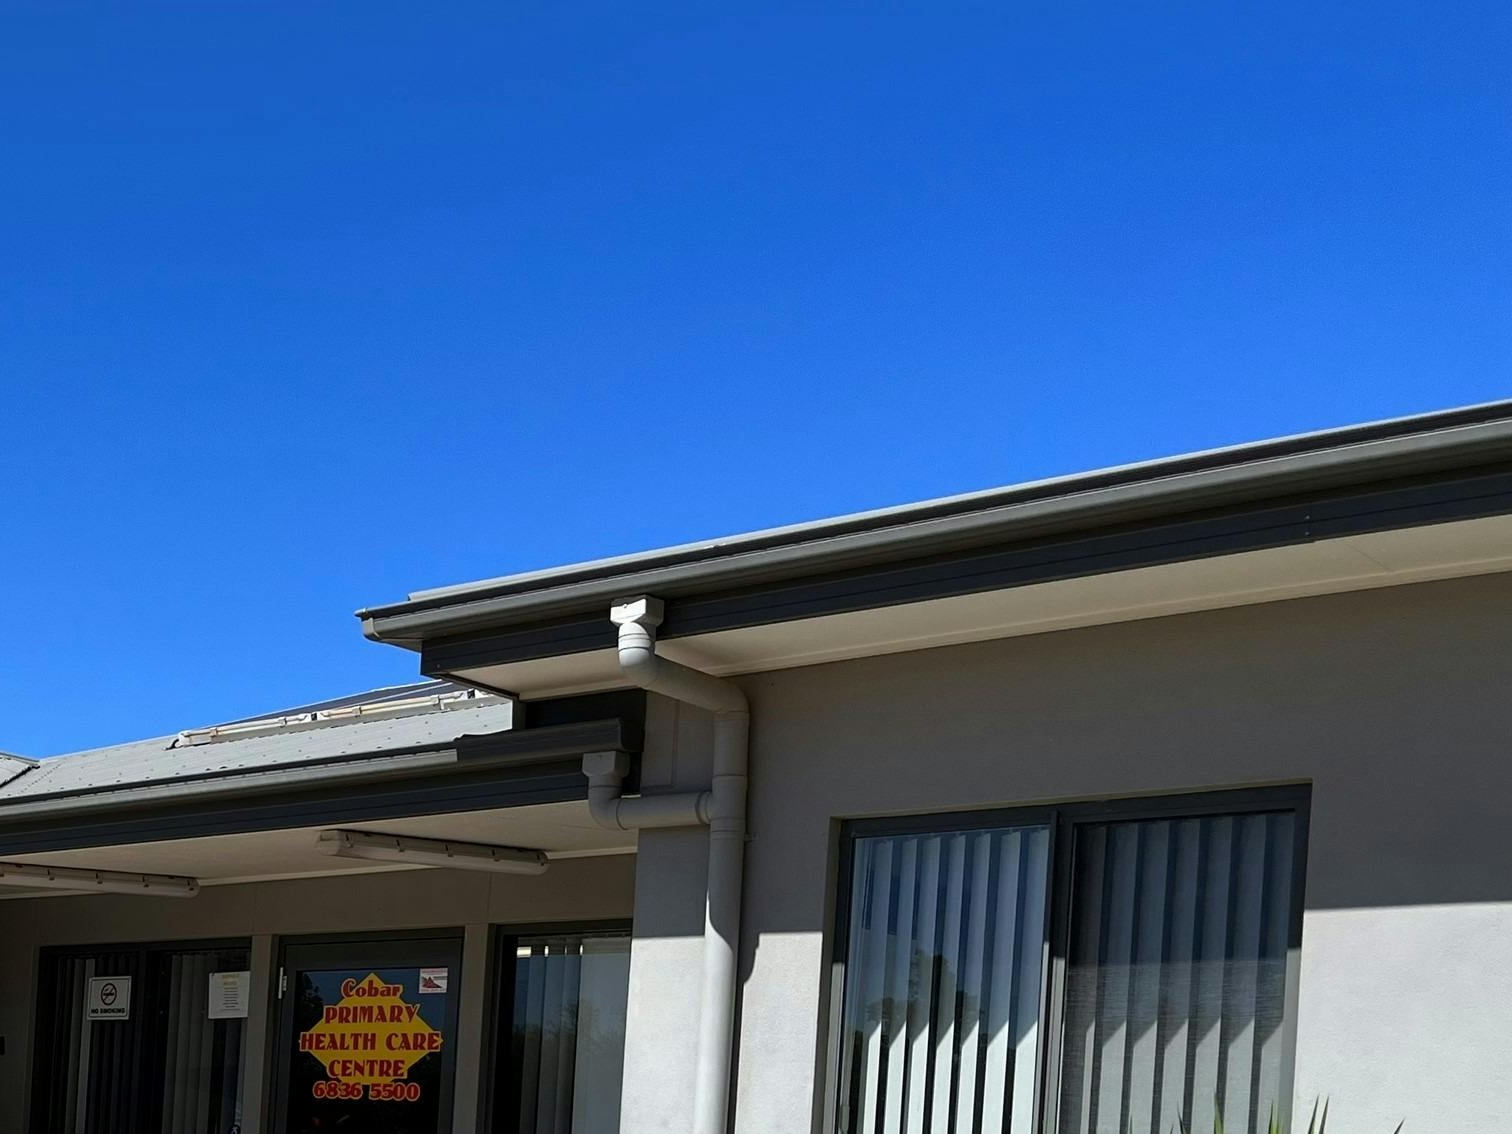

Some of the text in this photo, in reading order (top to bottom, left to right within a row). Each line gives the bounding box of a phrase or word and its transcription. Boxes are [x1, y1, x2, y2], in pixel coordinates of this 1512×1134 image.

[342, 979, 402, 998] Cobar
[324, 1004, 420, 1024] PRIMARY
[300, 1032, 441, 1051] HEALTH CARE
[327, 1058, 406, 1078] CENTRE
[313, 1081, 420, 1100] 6836 5500
